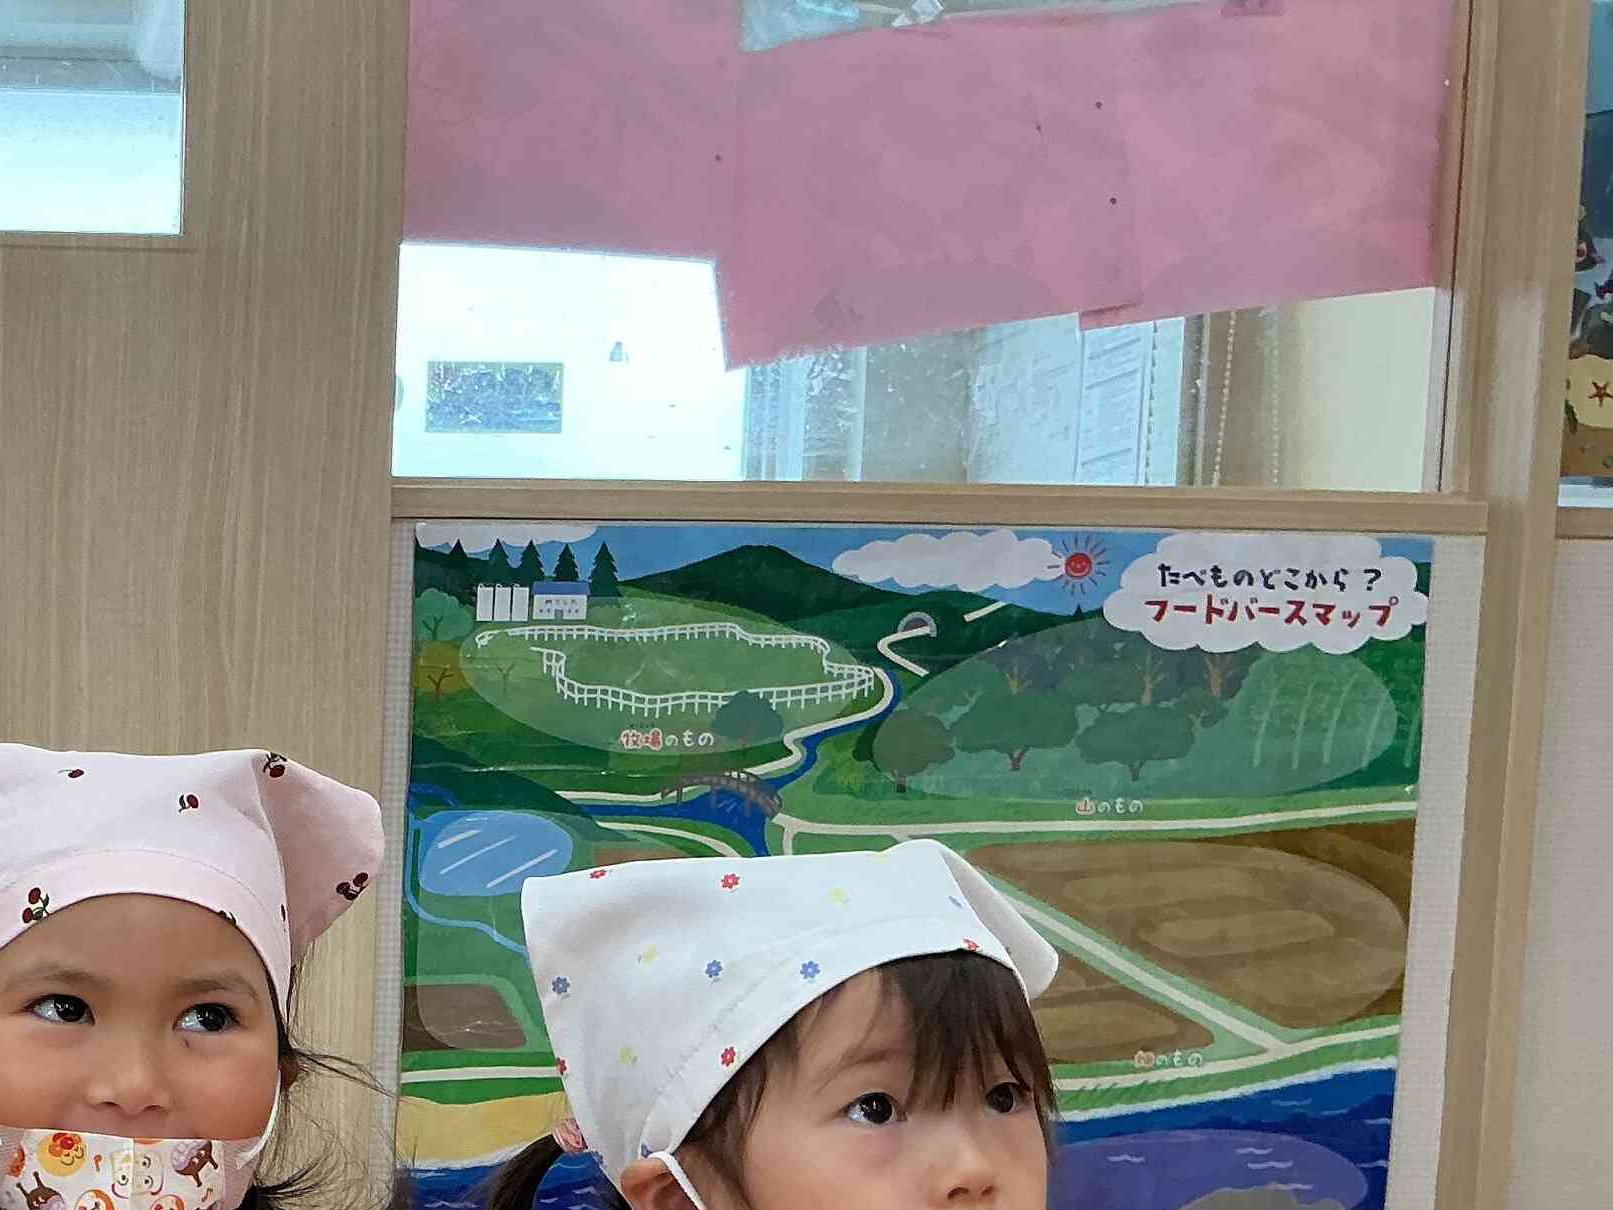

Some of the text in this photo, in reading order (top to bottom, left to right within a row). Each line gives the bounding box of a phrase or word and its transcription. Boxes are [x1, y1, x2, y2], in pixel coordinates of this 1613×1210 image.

[1144, 593, 1400, 628] フードバースマップ
